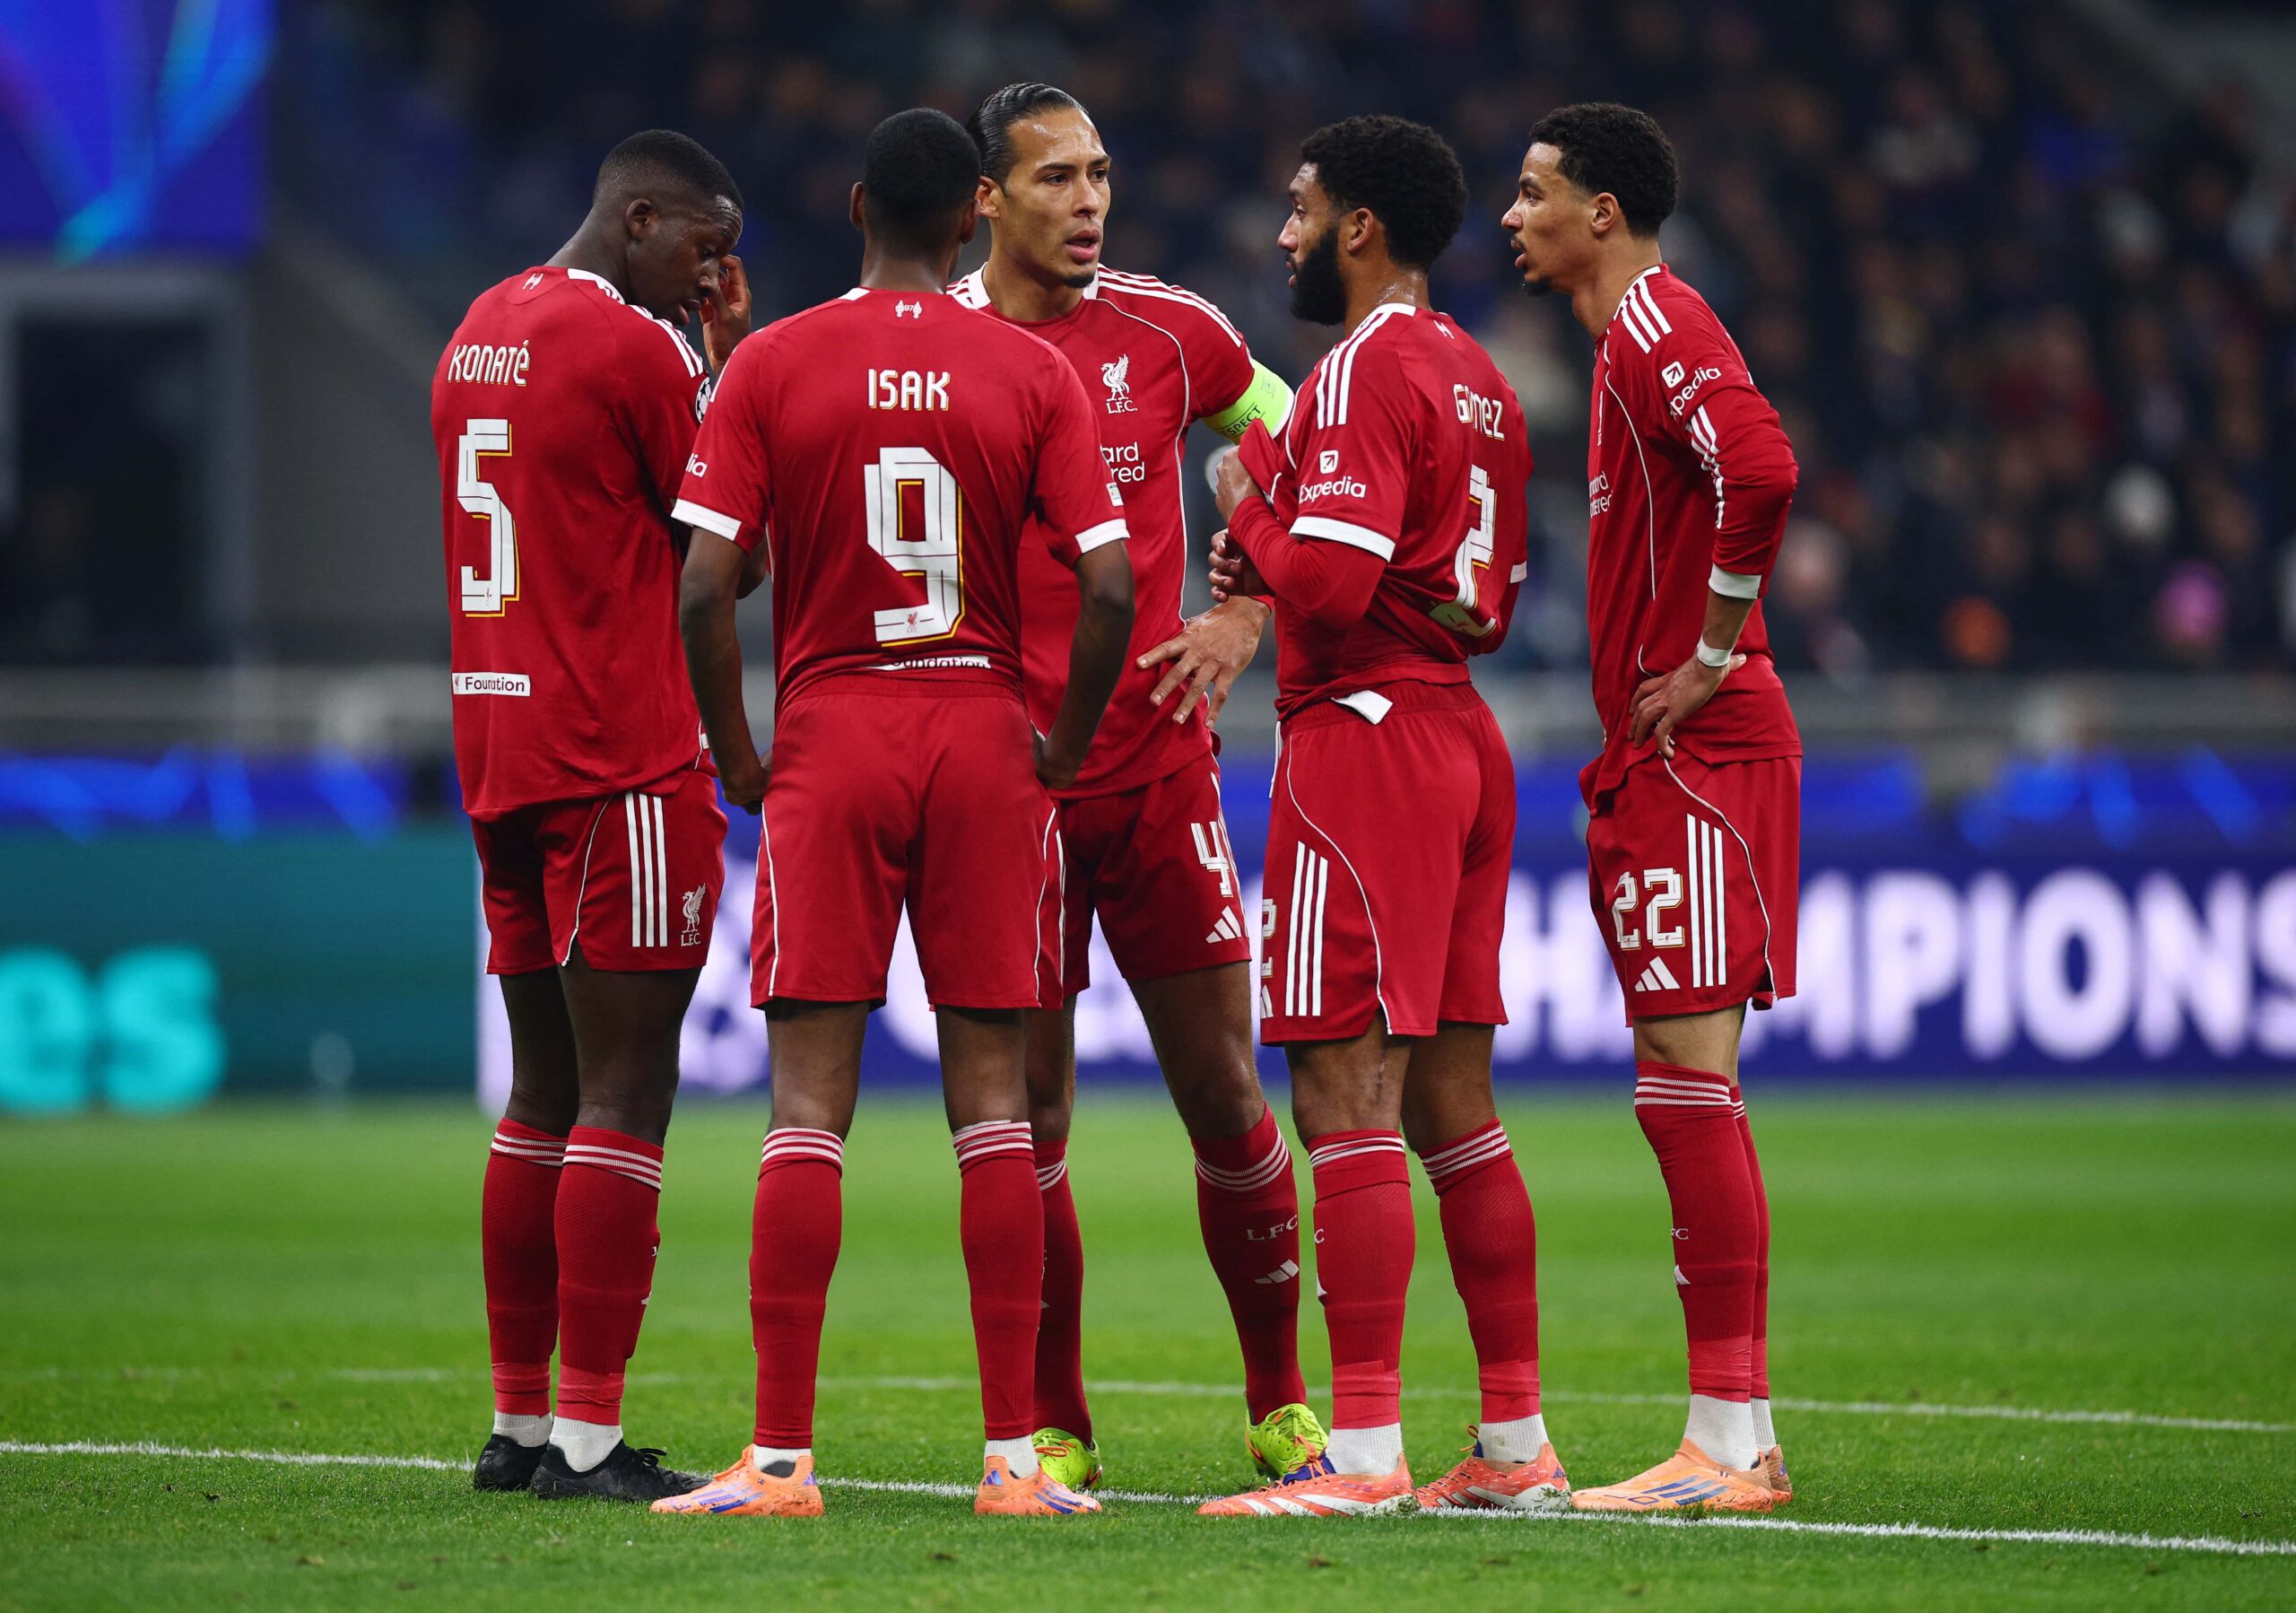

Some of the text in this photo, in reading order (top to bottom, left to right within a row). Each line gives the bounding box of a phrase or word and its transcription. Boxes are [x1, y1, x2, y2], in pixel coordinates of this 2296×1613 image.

[868, 368, 951, 411] ISAK
[1670, 367, 1722, 421] pedia
[457, 419, 520, 617] 5
[1299, 475, 1366, 503] Expedia
[864, 447, 965, 647] 9
[1190, 821, 1234, 898] 4
[1612, 868, 1685, 951] 22
